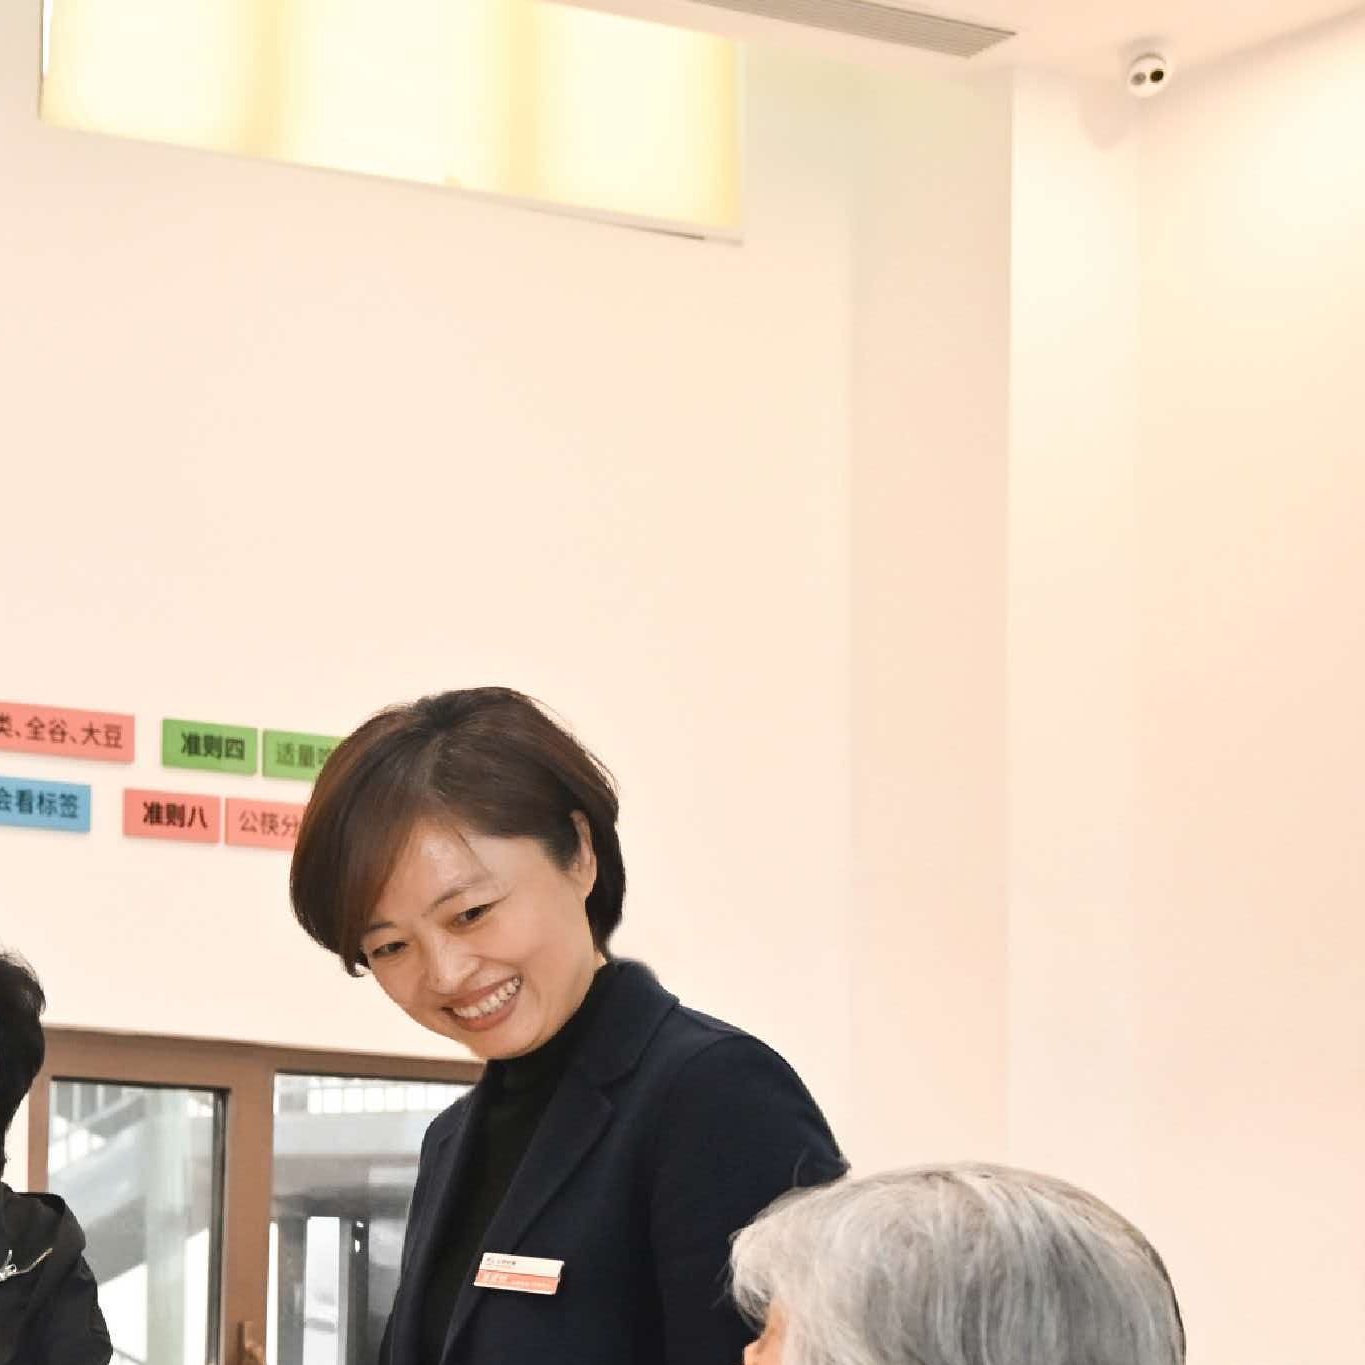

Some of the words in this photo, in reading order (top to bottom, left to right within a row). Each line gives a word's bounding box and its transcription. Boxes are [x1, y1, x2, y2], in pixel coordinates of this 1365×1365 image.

[180, 731, 246, 761] 准则四
[142, 800, 209, 829] 准则八
